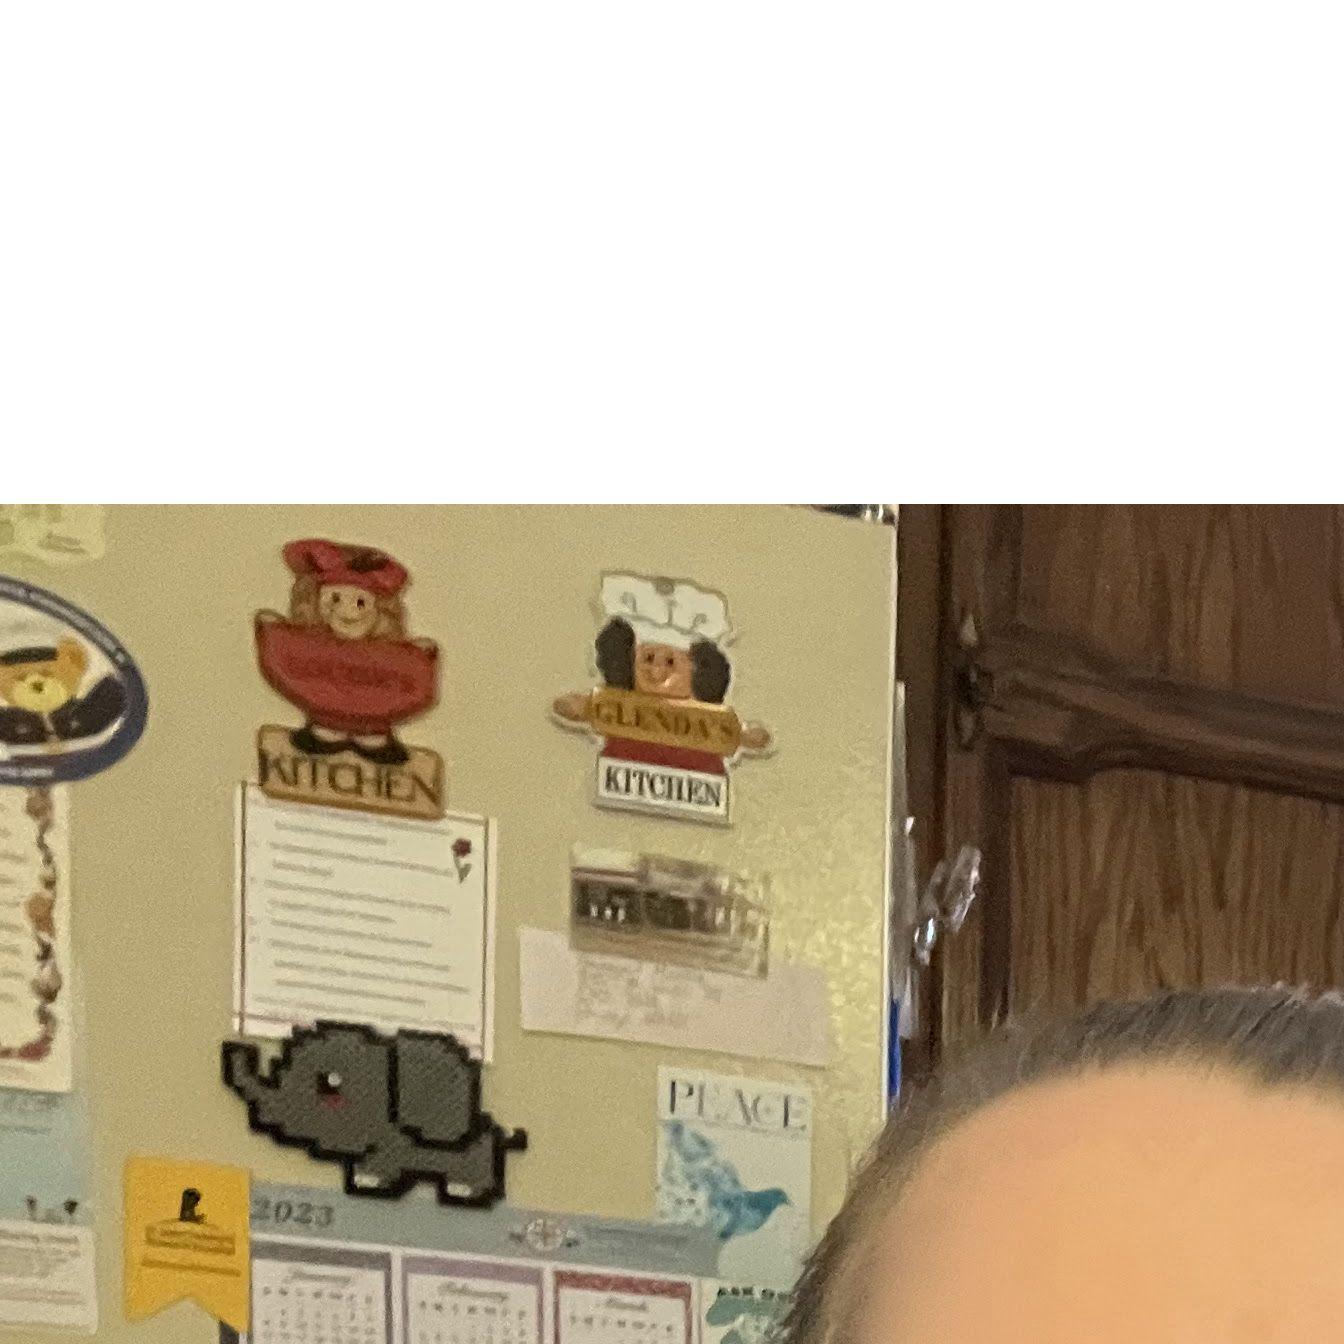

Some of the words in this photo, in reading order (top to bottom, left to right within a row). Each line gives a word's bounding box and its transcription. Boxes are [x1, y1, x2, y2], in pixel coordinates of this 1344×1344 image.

[257, 752, 442, 807] KITCHEN
[605, 766, 721, 808] KITCHEN
[669, 1079, 807, 1134] PEACE
[250, 1196, 335, 1228] 2023
